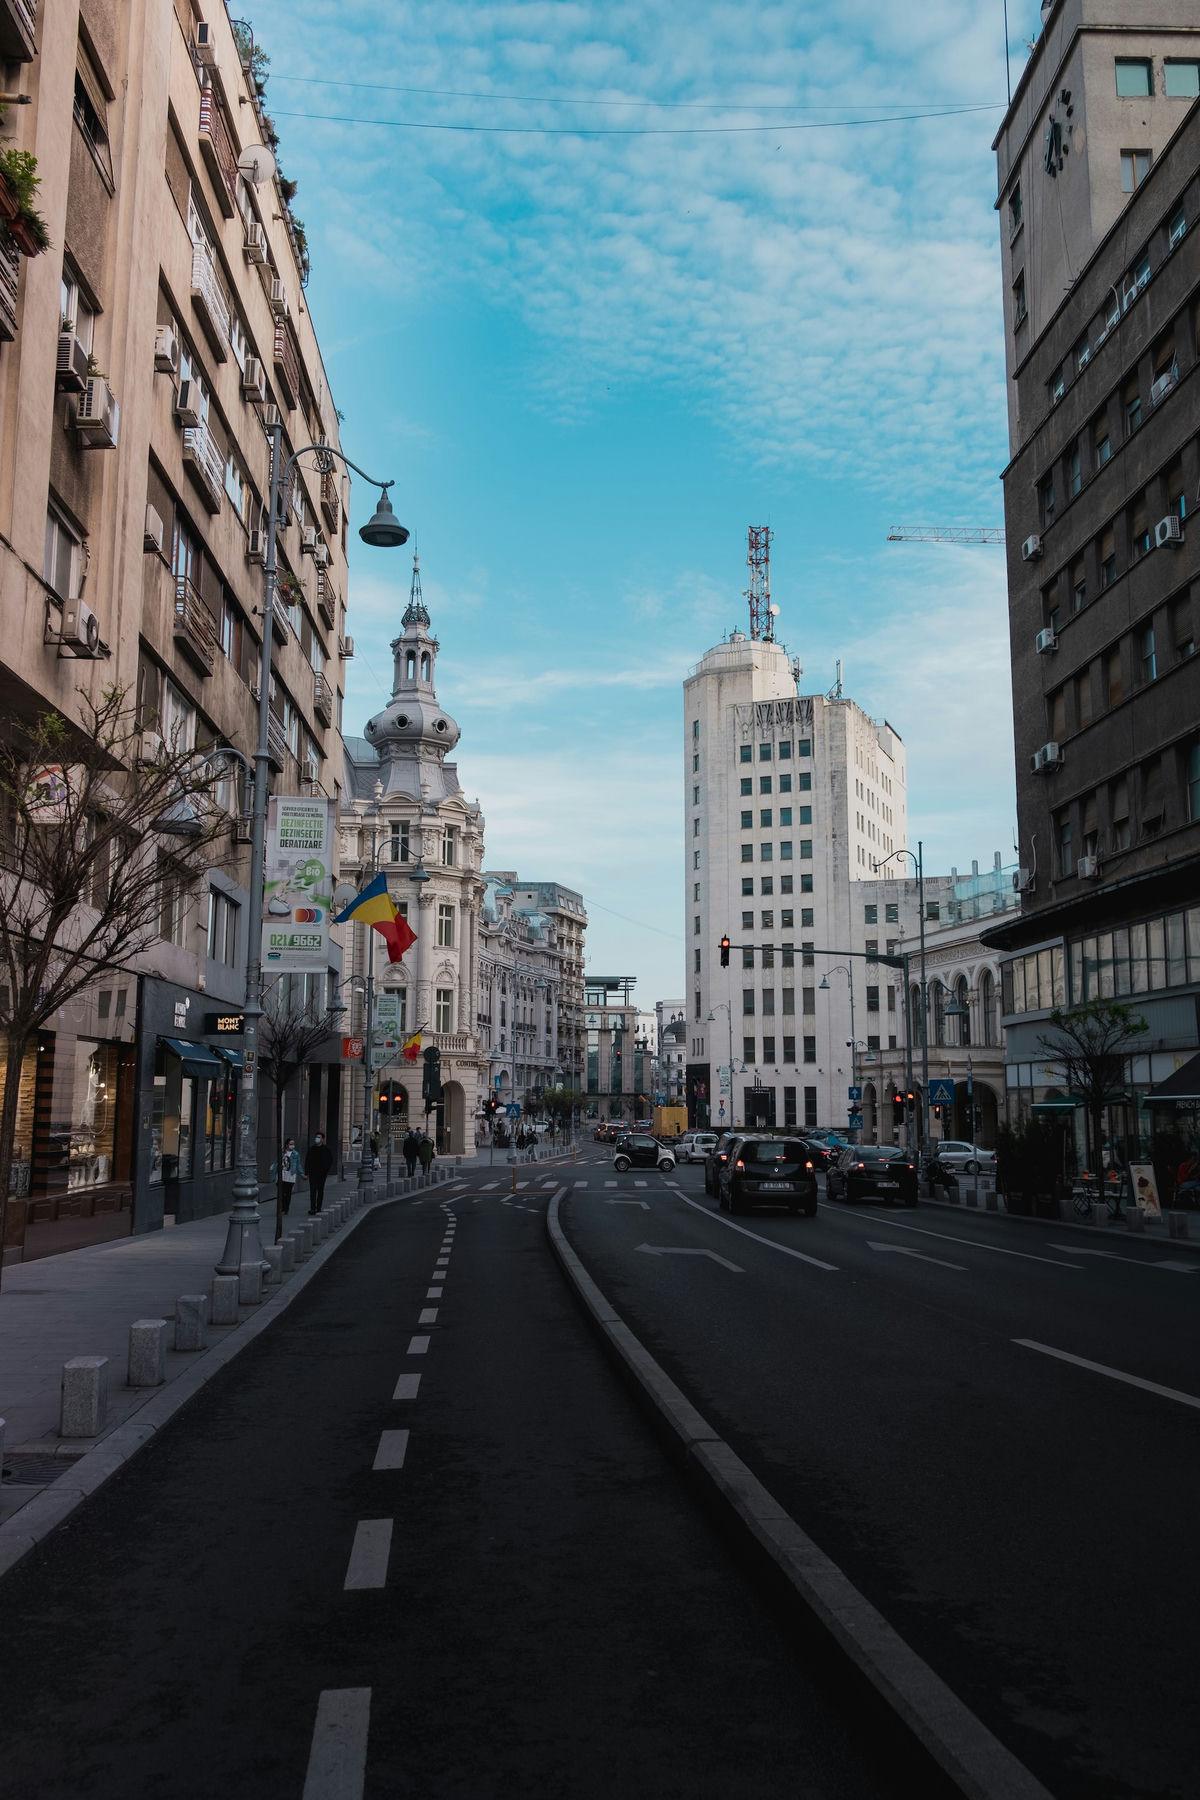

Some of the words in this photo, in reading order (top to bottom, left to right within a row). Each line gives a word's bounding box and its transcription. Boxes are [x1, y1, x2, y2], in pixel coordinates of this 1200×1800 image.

[281, 818, 324, 829] DEZINFECTIE
[280, 828, 324, 839] DEZINSECTIE
[279, 839, 323, 849] DERATIZARE
